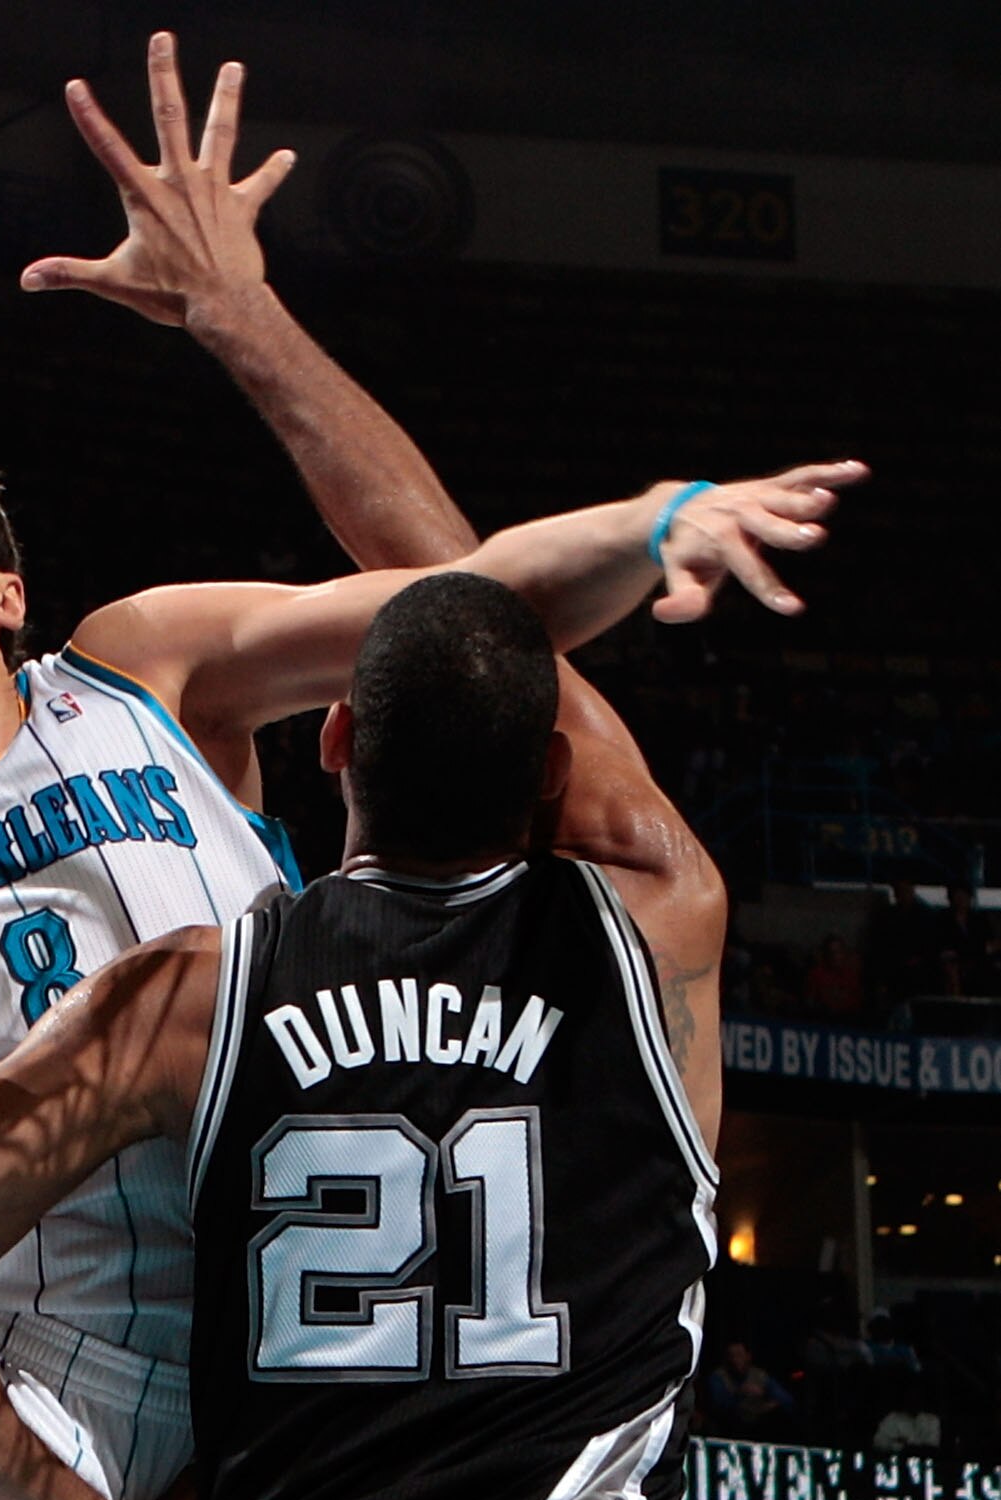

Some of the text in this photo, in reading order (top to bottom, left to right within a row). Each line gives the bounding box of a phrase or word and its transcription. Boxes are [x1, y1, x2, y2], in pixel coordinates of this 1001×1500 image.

[670, 184, 790, 243] 320
[264, 977, 565, 1090] DUNCAN
[779, 1027, 822, 1078] BY
[827, 1033, 911, 1090] ISSUE
[918, 1038, 942, 1092] &
[951, 1043, 1001, 1093] LO
[247, 1105, 572, 1383] 21
